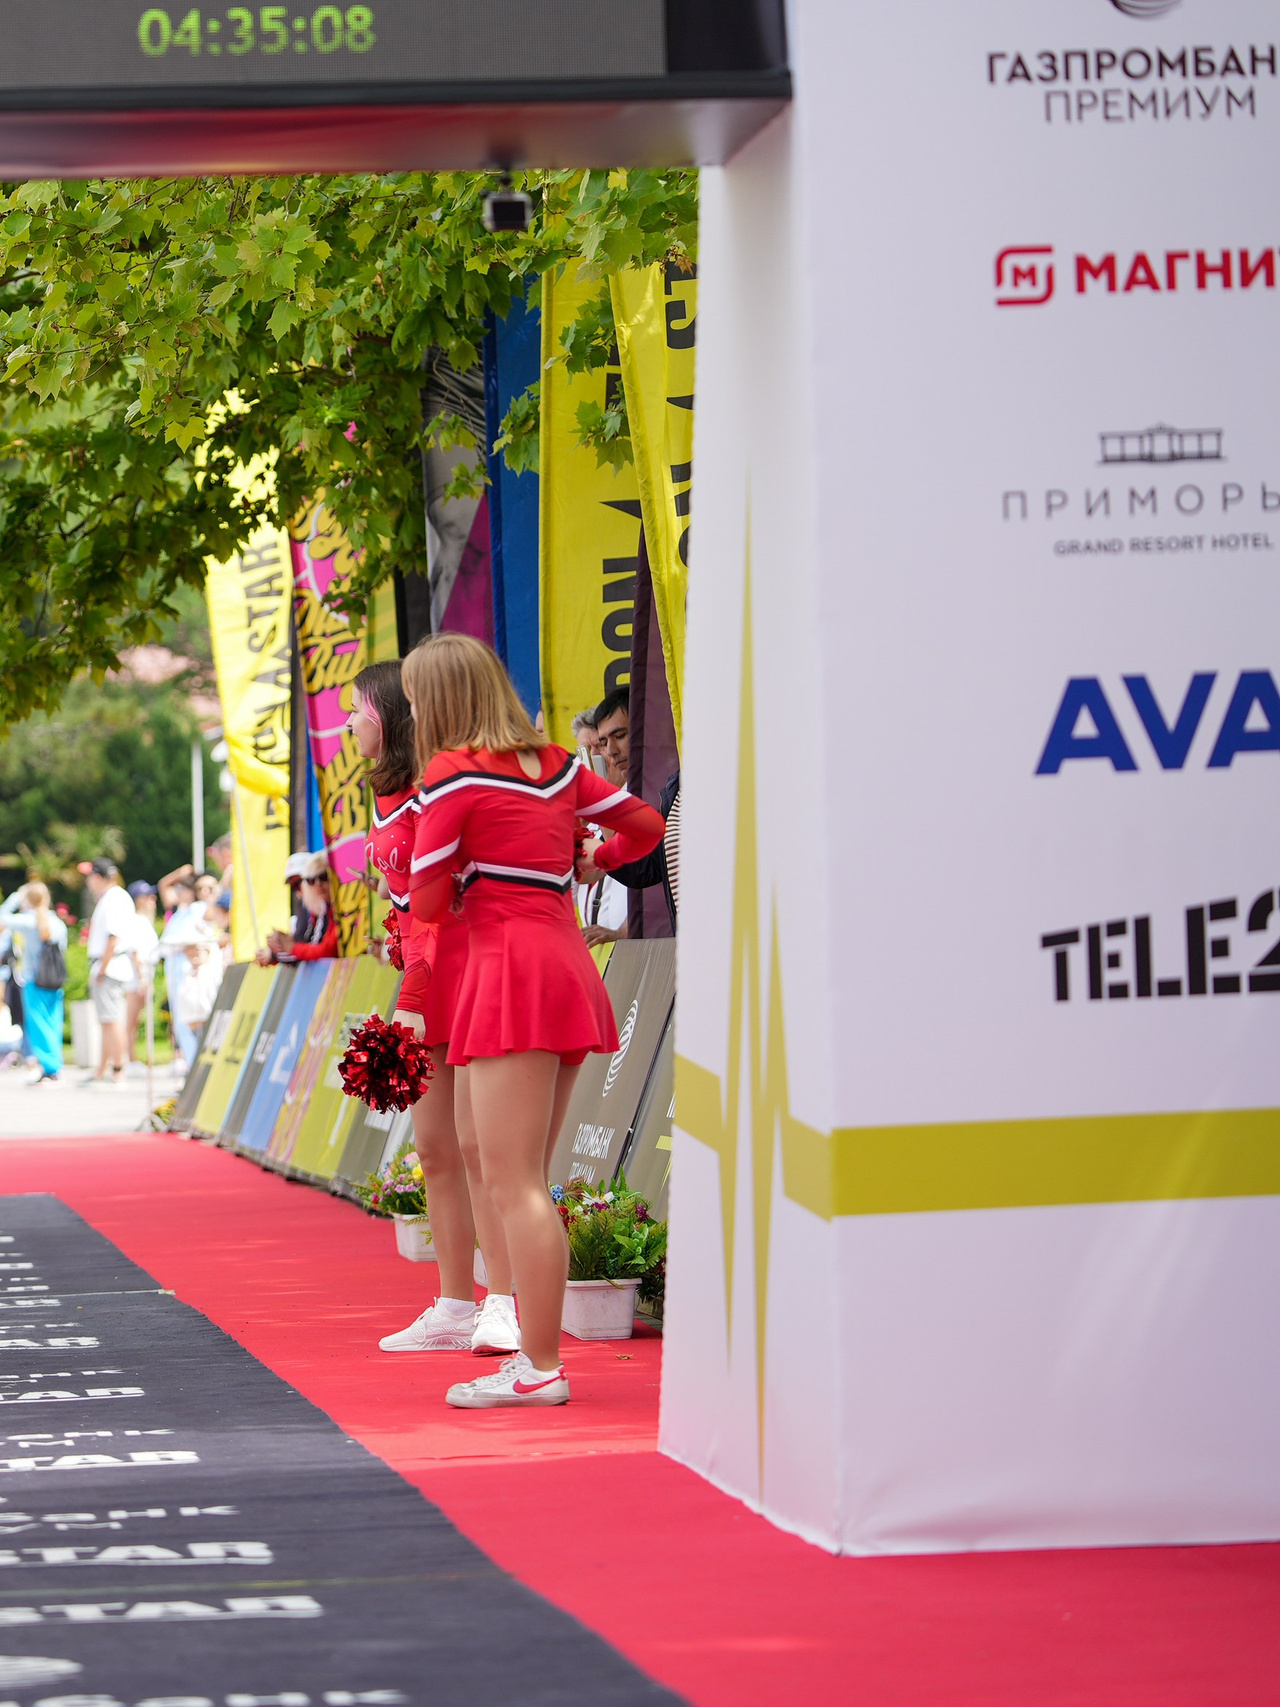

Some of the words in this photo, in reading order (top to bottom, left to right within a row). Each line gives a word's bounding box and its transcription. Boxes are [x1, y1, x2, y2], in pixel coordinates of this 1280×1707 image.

[138, 4, 376, 57] 04:35:08
[987, 44, 1278, 84] ГАЗПРОМБАН
[1044, 85, 1256, 123] ПРЕМИУМ
[1075, 248, 1280, 294] МАГНИ
[1053, 538, 1124, 557] GRAND
[1129, 534, 1204, 553] RESORT
[1211, 532, 1274, 551] HOTEL
[1033, 668, 1280, 776] AVA
